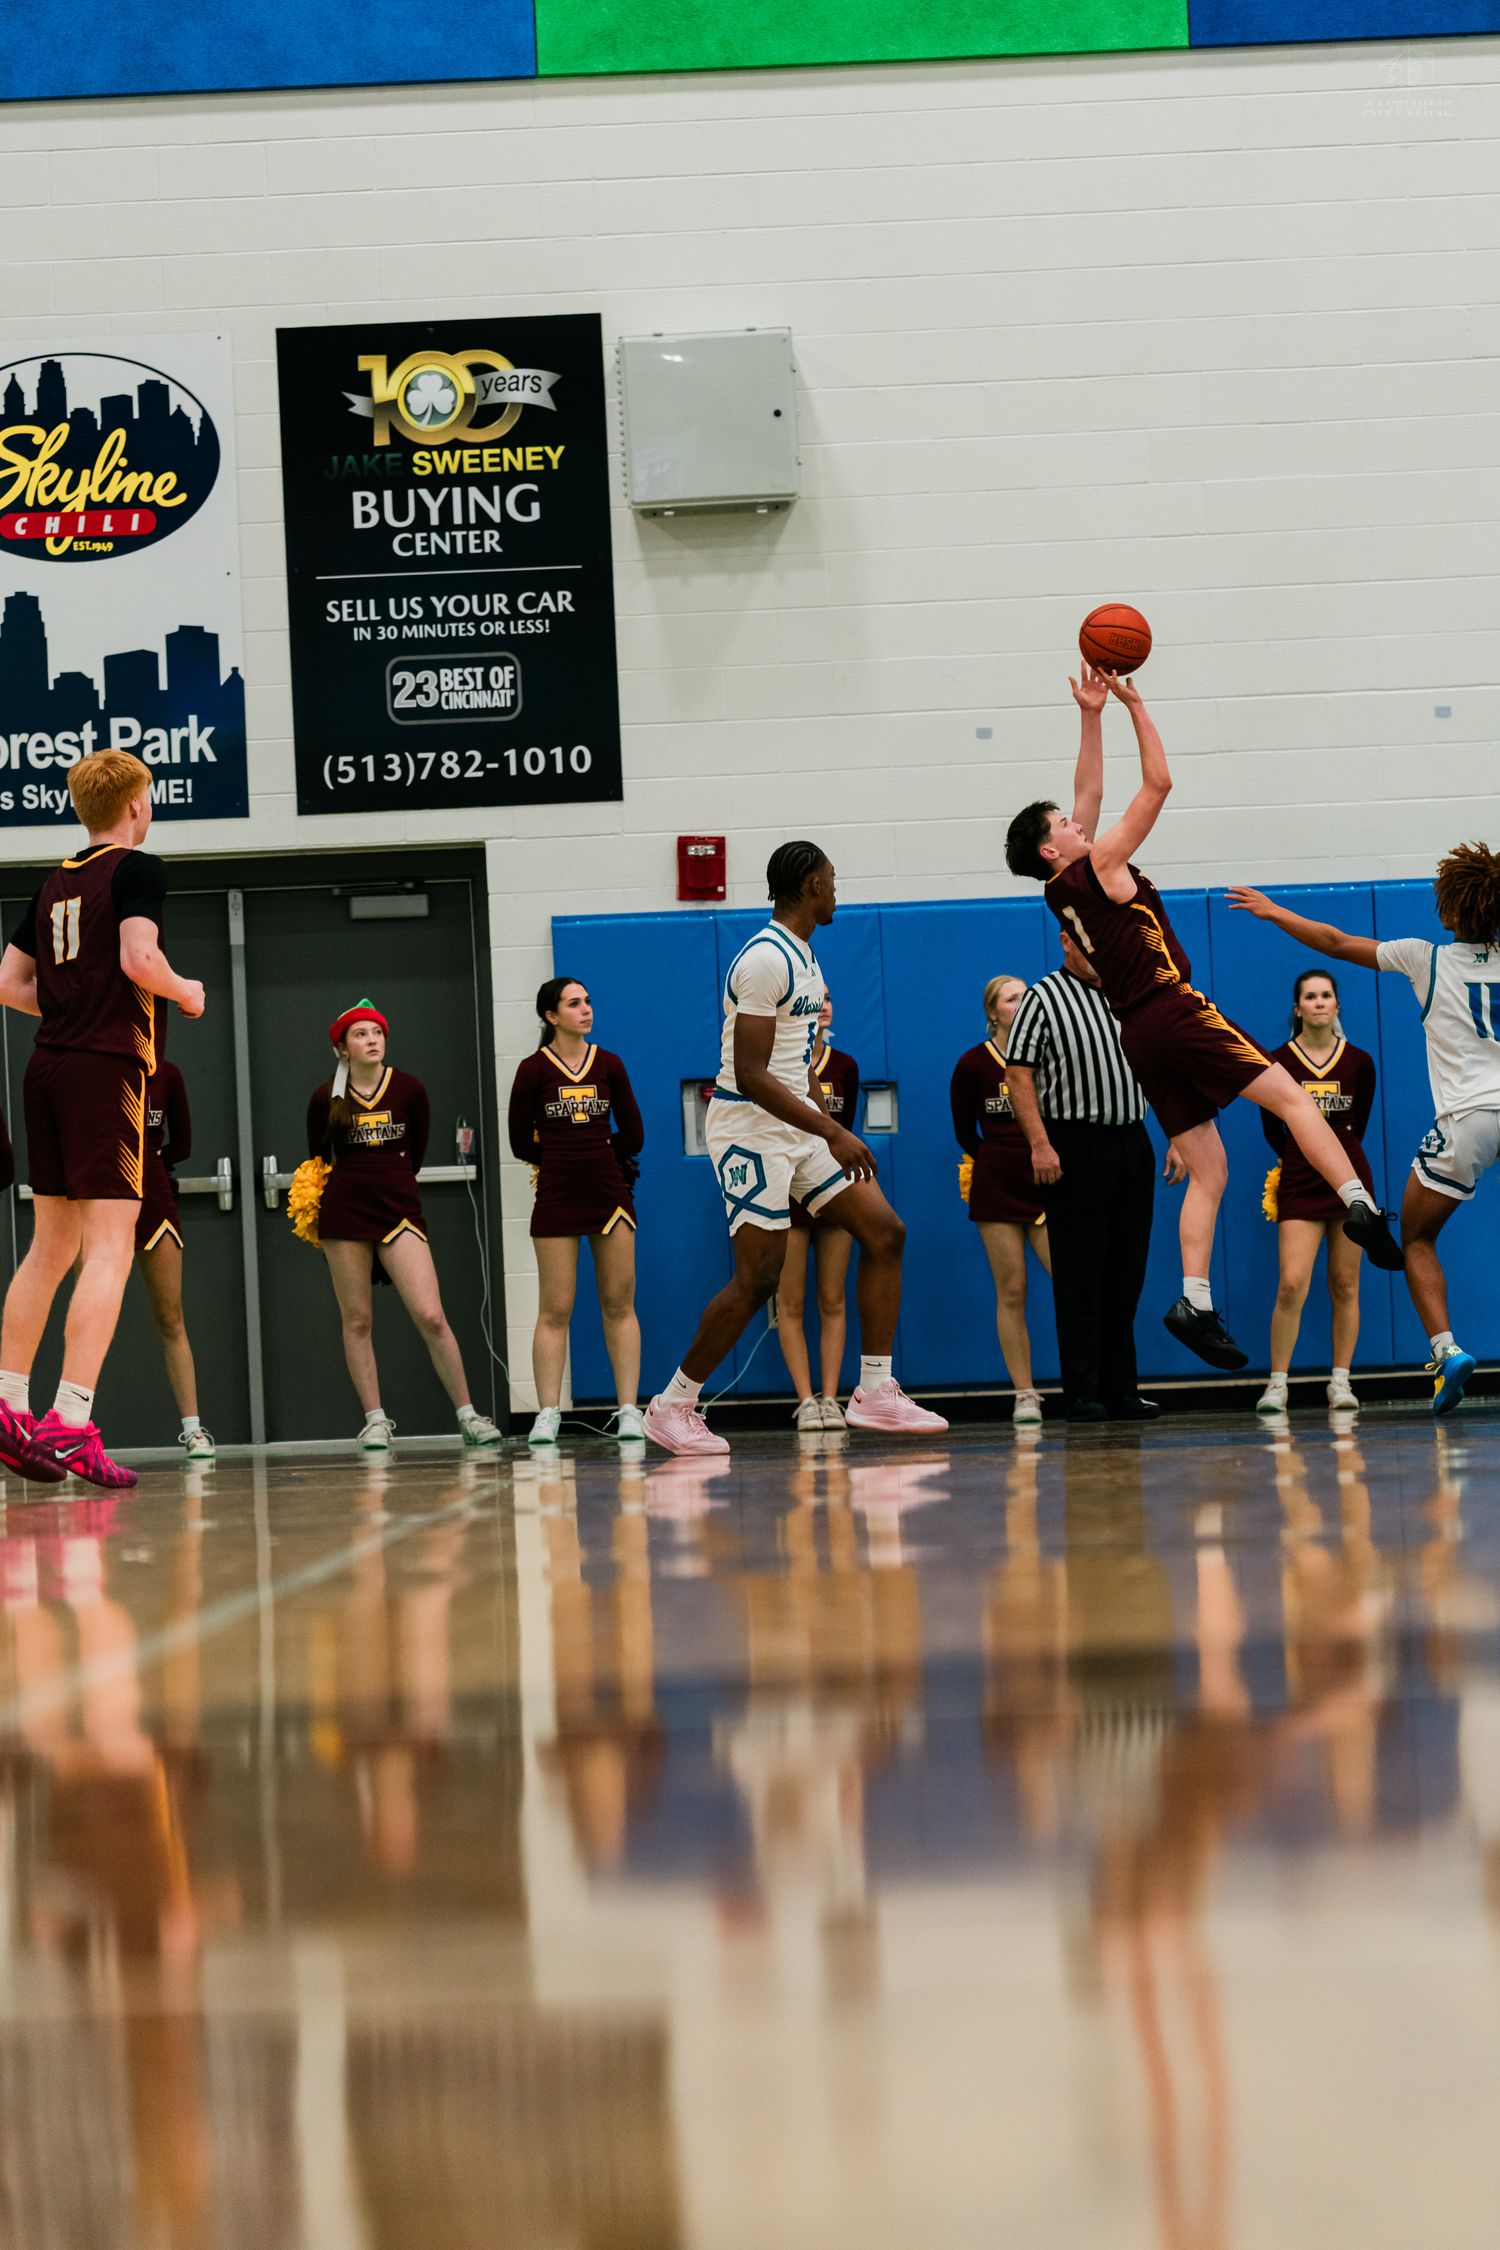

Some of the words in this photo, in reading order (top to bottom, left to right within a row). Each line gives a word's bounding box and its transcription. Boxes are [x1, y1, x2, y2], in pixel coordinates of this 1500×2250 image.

[481, 373, 543, 400] years
[323, 452, 403, 479] JAKE
[412, 445, 566, 476] SWEENEY
[0, 422, 188, 556] Skyline
[352, 483, 541, 529] BUYING
[14, 512, 140, 536] CHILI
[392, 529, 504, 557] CENTER
[325, 599, 382, 623] SELL
[388, 596, 424, 620] US
[430, 592, 512, 618] YOUR
[517, 590, 576, 615] CAR
[353, 626, 371, 641] IN
[376, 624, 399, 641] 30
[402, 621, 476, 639] MINUTES
[480, 620, 506, 636] OR
[510, 618, 551, 635] LESS!
[392, 670, 440, 709] 23
[439, 666, 485, 692] BEST
[489, 665, 515, 690] OF
[0, 719, 98, 770] rest
[109, 714, 218, 766] Park
[323, 744, 593, 791] (513)782-1010
[22, 784, 75, 815] Sky
[149, 778, 193, 805] ME!
[49, 895, 82, 966] 11
[1061, 904, 1096, 955] 1
[544, 1099, 610, 1118] SPARTANS
[558, 1085, 598, 1124] T
[1313, 1095, 1354, 1112] RTANS
[347, 1123, 406, 1144] PARTANS
